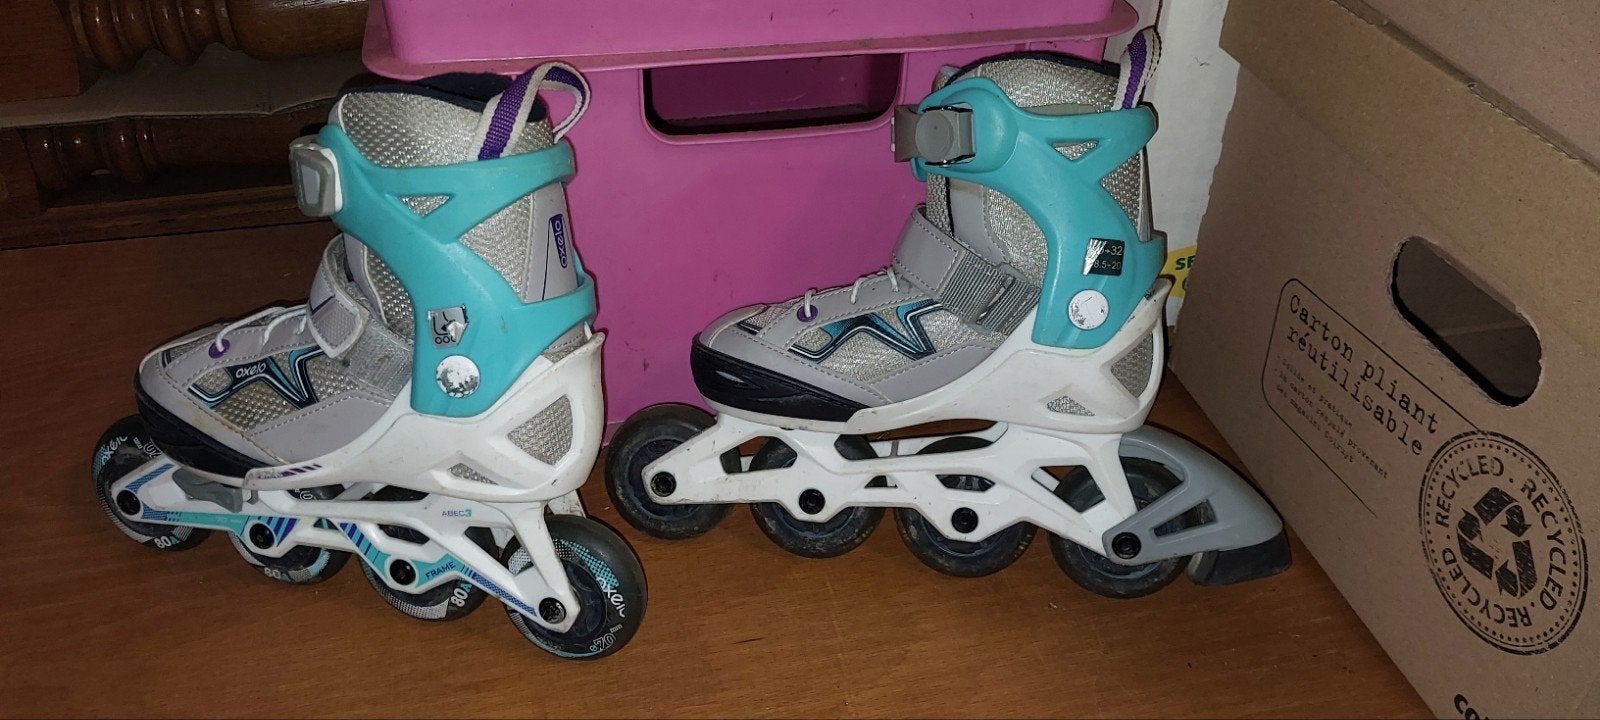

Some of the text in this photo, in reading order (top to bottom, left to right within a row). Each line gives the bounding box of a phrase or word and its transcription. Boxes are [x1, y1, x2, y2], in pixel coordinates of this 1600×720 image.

[555, 220, 567, 268] oxelo
[235, 361, 267, 379] oxelo
[1287, 326, 1423, 456] réutilisable
[1290, 294, 1438, 434] Carton pliant
[1435, 455, 1504, 528] RECYCLED
[425, 561, 456, 580] FRAME
[1520, 478, 1567, 611] RECYCLED
[450, 581, 473, 607] 80A
[1442, 547, 1533, 628] RECYCLED
